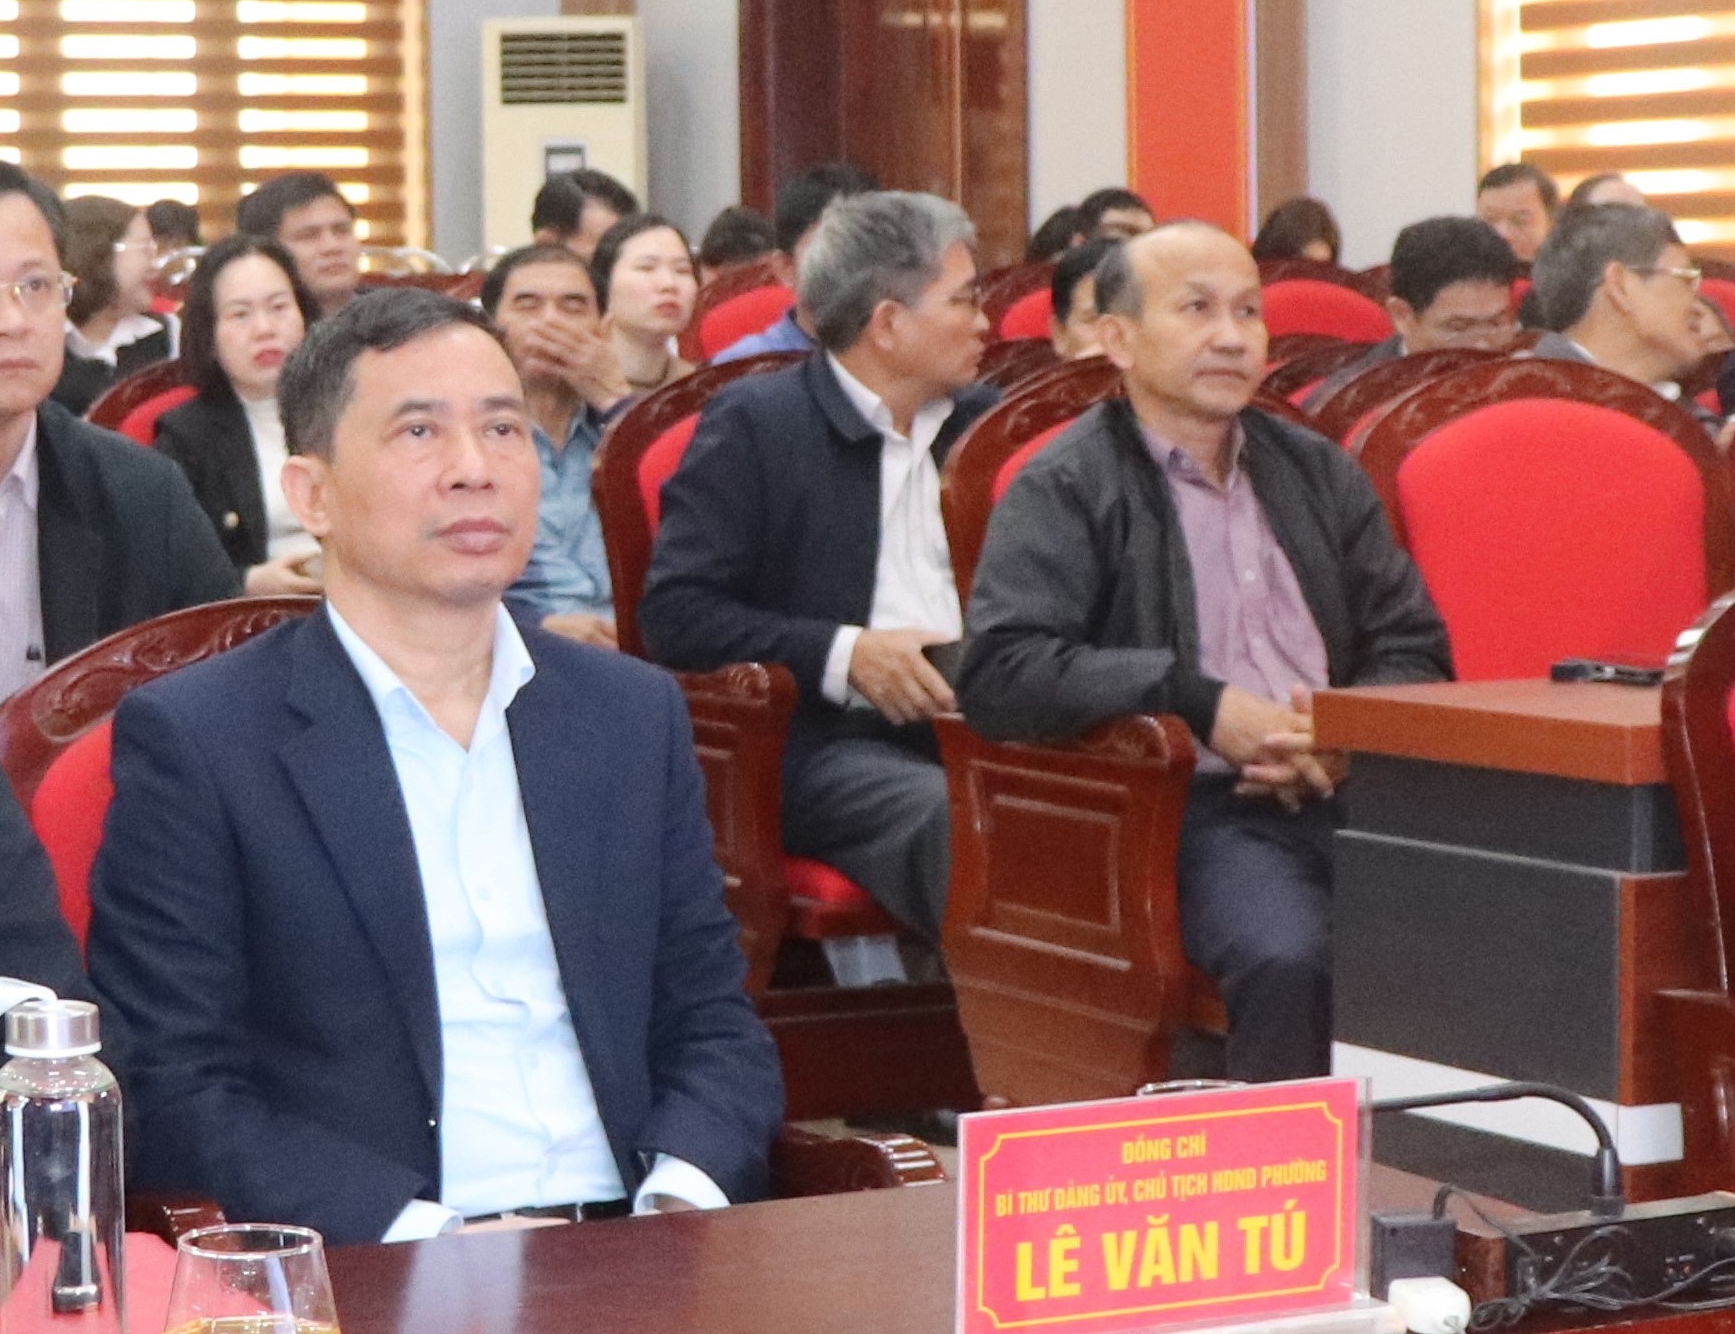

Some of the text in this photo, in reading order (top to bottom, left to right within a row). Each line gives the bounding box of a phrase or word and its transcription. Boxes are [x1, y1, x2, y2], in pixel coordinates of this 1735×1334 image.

[1122, 1129, 1207, 1165] ĐỒNG CHÍ
[995, 1157, 1327, 1217] BÍ THƯ ĐẢNG ỦY, CHỦ TỊCH HĐND PHƯỜNG
[1016, 1198, 1306, 1302] LÊ VĂN TÚ
